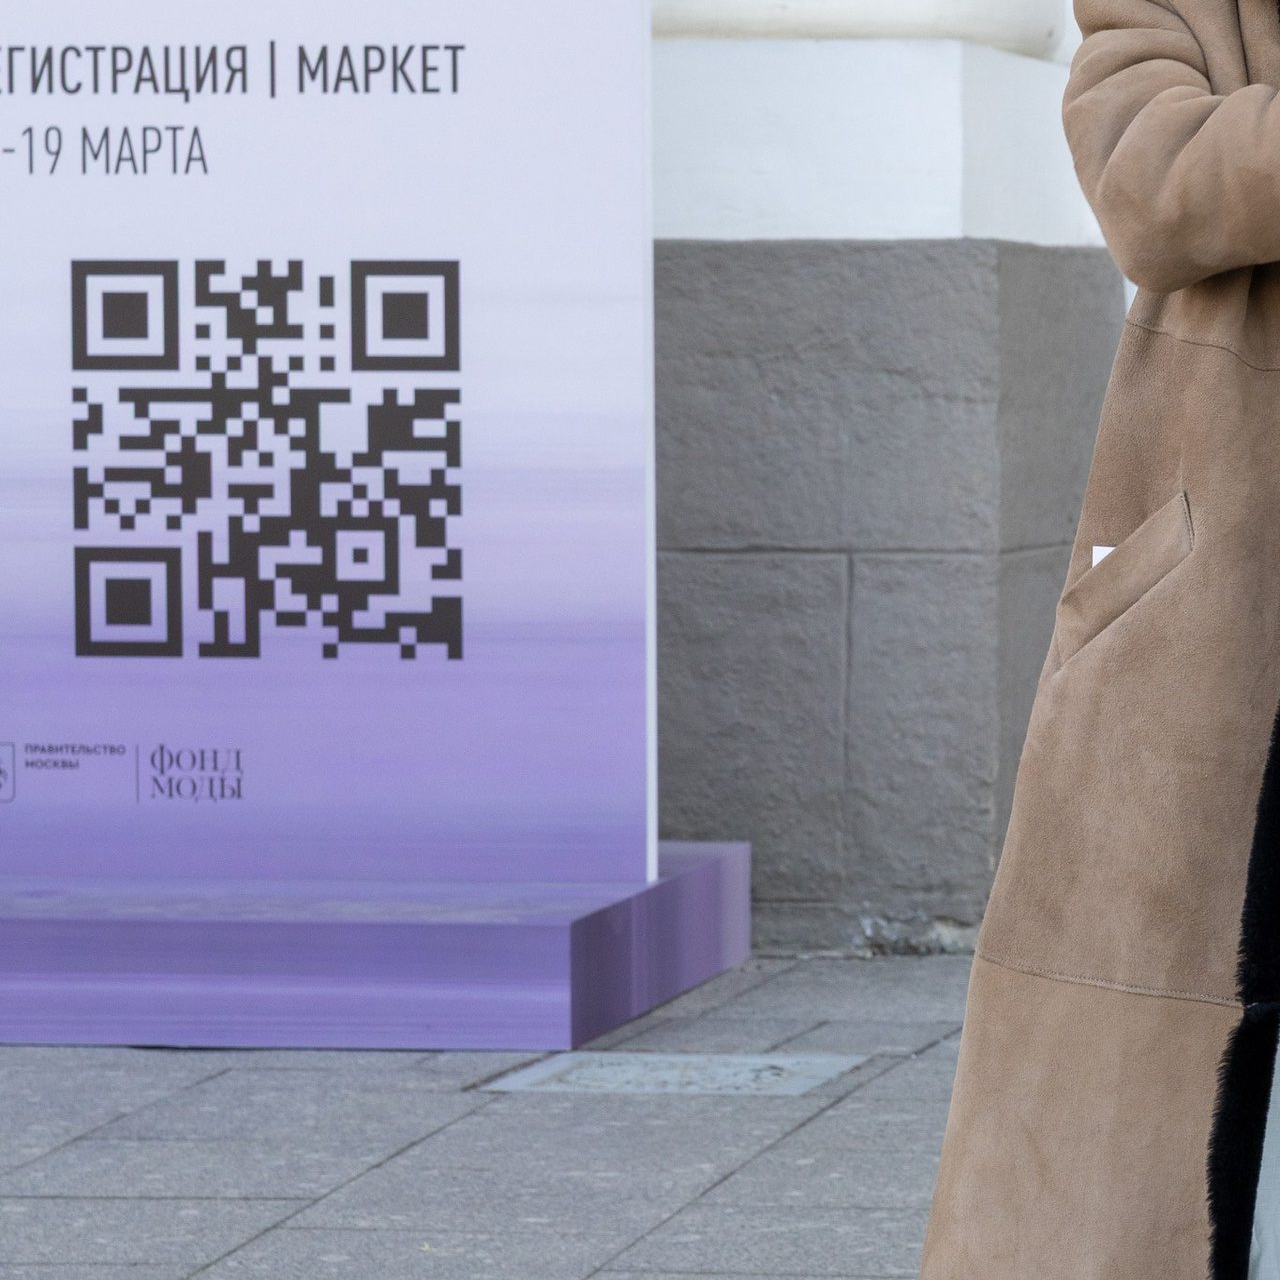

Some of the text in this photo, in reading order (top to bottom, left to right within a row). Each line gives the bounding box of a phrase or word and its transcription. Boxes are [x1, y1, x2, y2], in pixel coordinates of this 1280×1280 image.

[0, 46, 248, 103] ГИСТРАЦИЯ
[298, 45, 466, 94] МАРКЕТ
[82, 126, 209, 175] МАРТА
[24, 743, 127, 756] ПРАВИТЕЛЬСТВО
[150, 744, 244, 774] ФОНД
[24, 758, 80, 770] МОСКВЫ
[151, 775, 243, 802] МОДЫ
